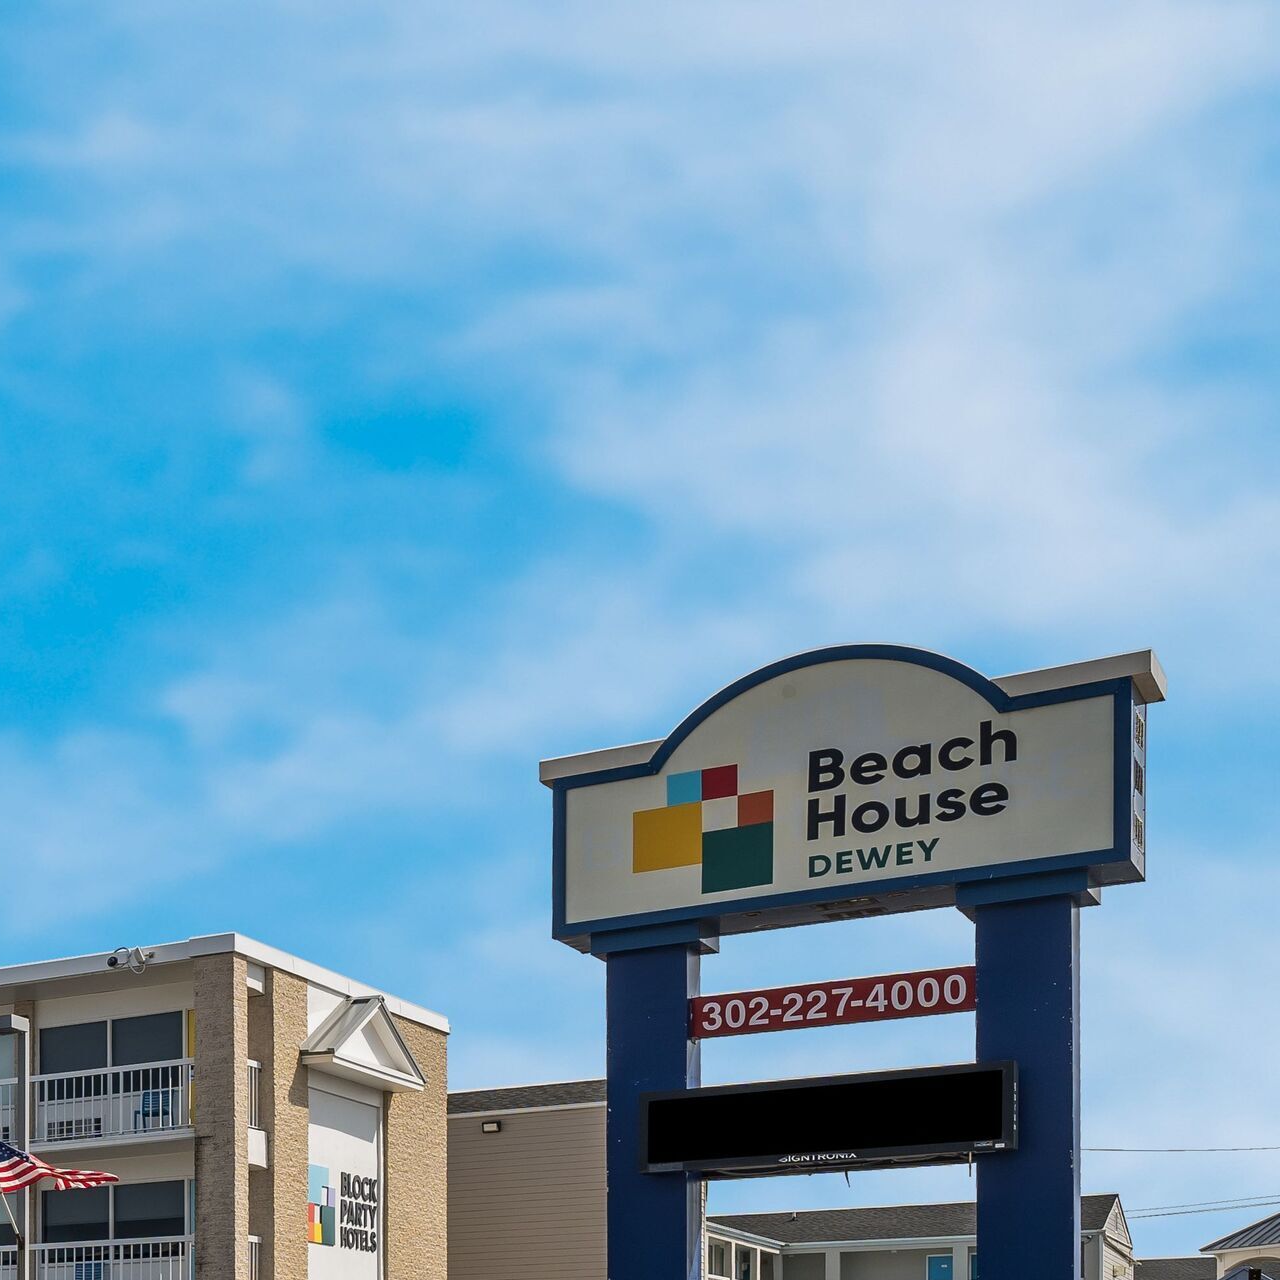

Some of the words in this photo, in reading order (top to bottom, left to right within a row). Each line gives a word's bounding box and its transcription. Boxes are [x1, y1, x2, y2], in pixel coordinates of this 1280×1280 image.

[808, 720, 1017, 793] Beach
[807, 782, 1009, 841] House
[809, 838, 940, 878] DEWEY
[702, 974, 967, 1031] 302-227-4000
[340, 1171, 377, 1204] BLOCK
[340, 1198, 377, 1230] PARTY
[340, 1225, 377, 1253] HOTELS
